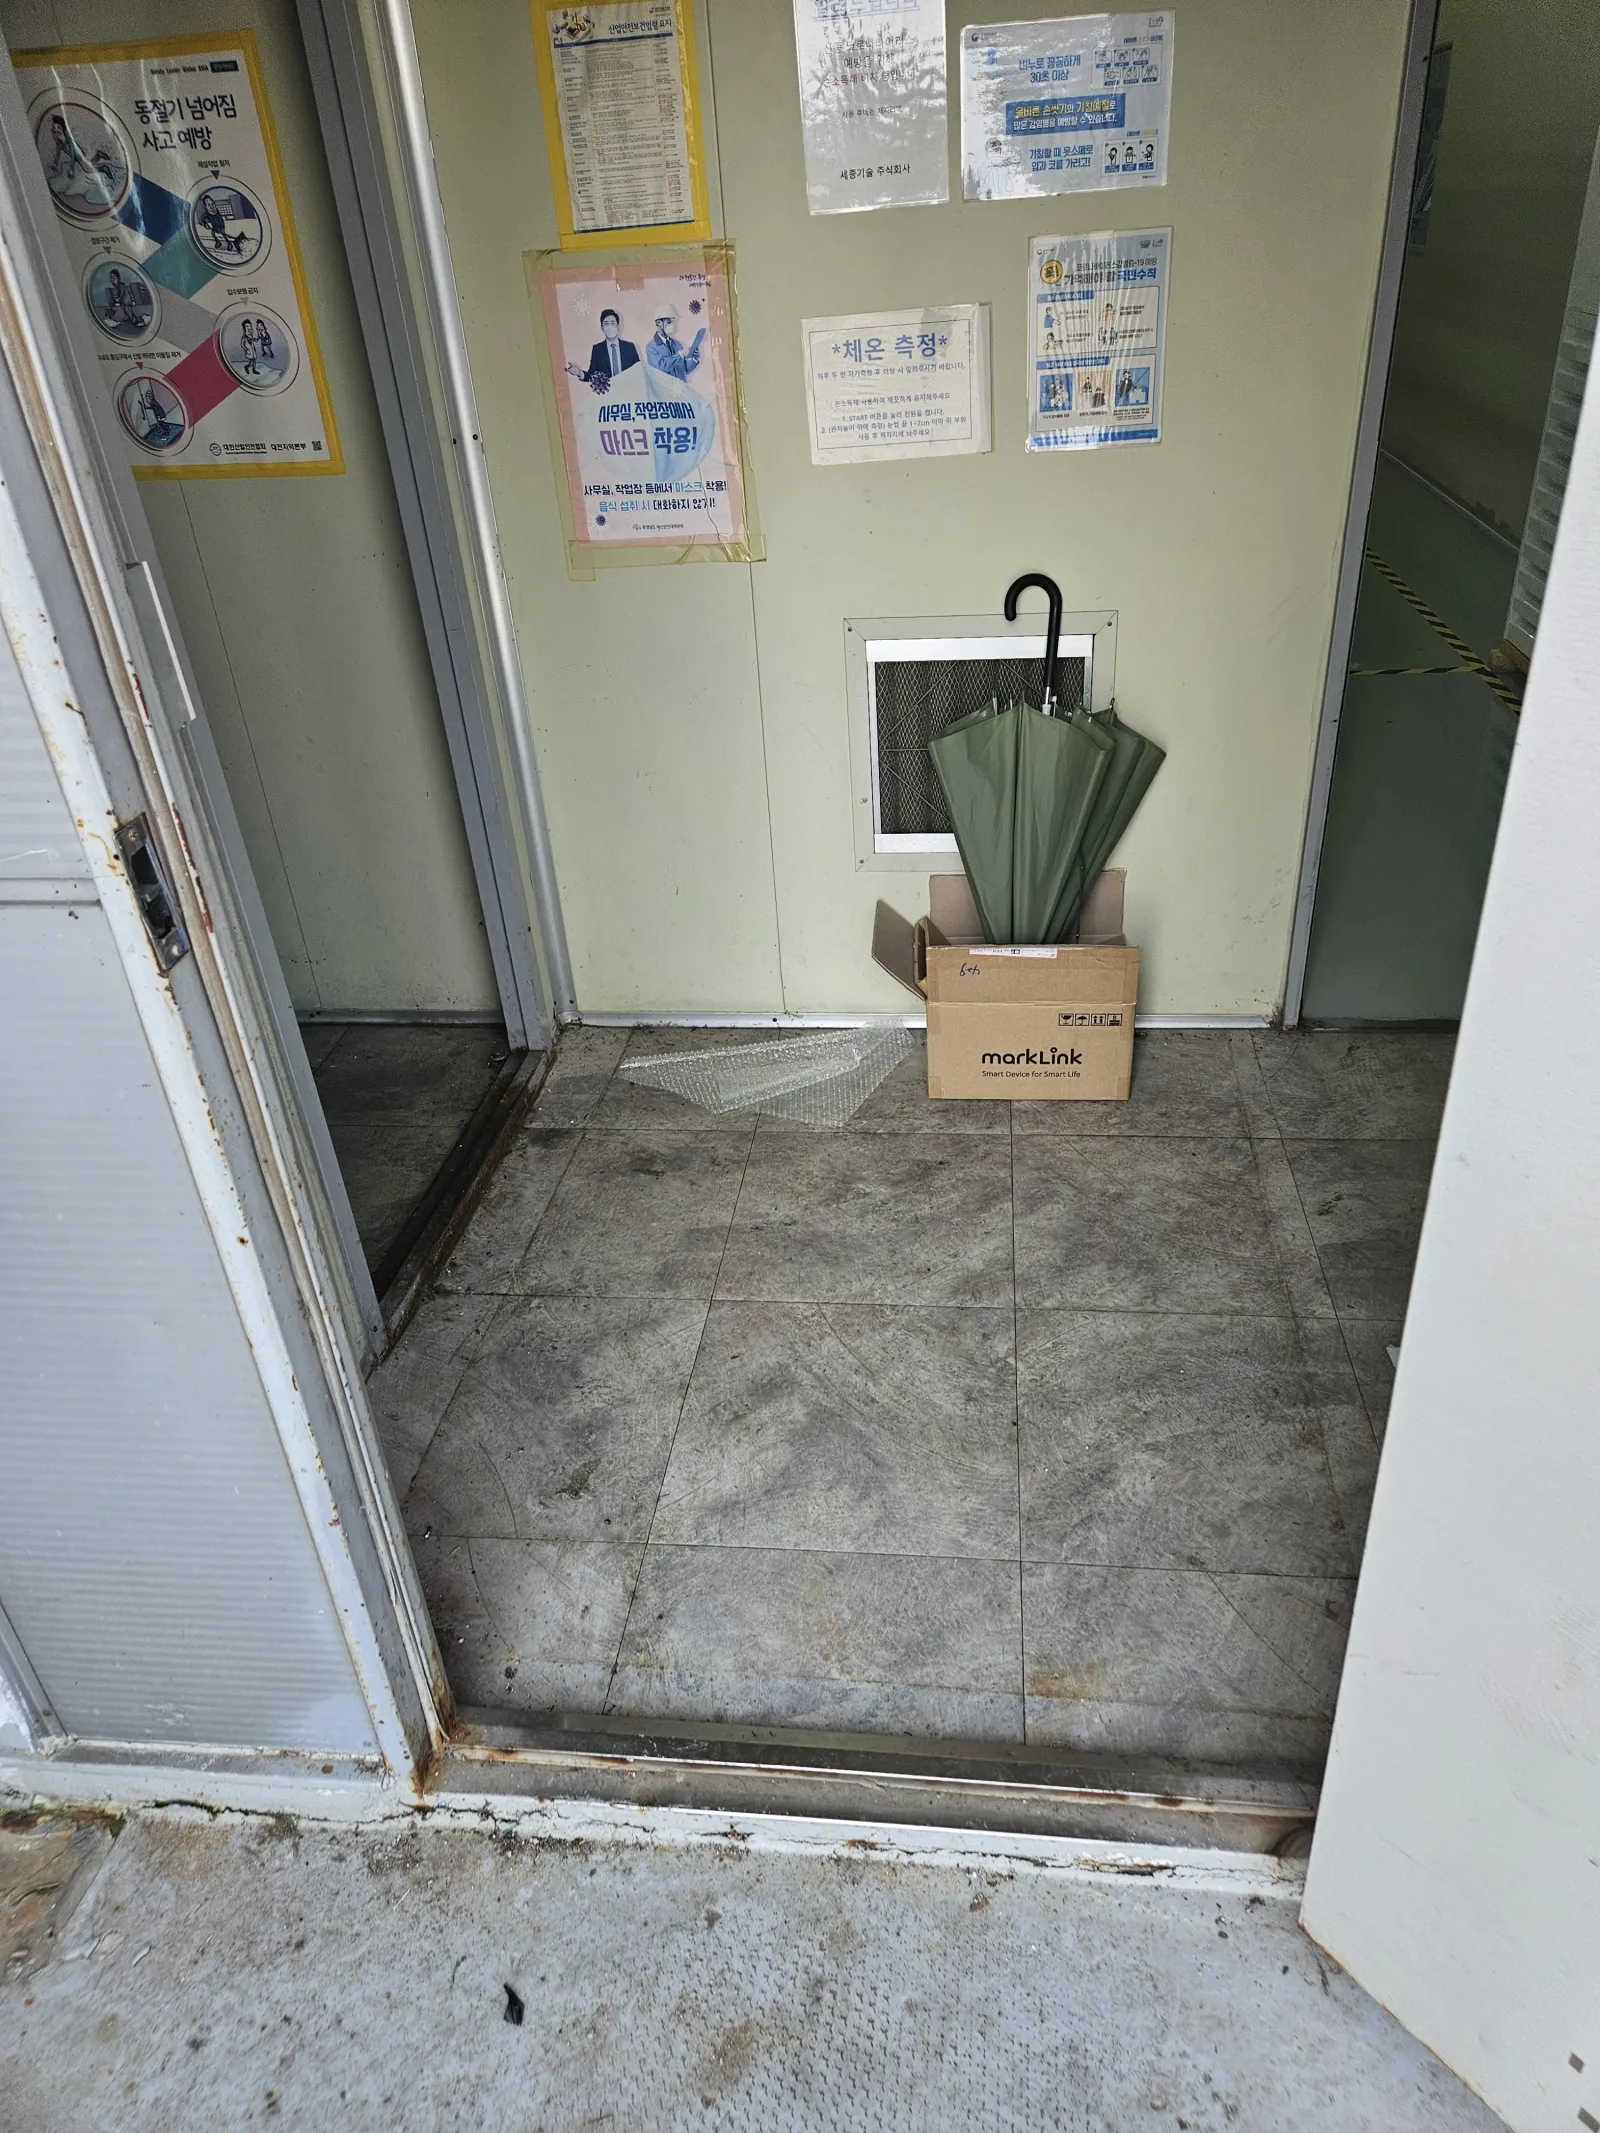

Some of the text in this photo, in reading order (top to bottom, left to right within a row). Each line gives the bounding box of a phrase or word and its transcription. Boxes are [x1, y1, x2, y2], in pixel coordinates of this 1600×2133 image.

[1019, 58, 1044, 70] 비누로
[1047, 54, 1080, 68] 꼼꼼하게
[1031, 69, 1069, 83] 30초 이상
[135, 94, 237, 125] 동절기 넘어짐
[1015, 100, 1116, 118] 올바른 손씻기와 기침예절로
[1013, 120, 1028, 130] 많은
[1057, 117, 1077, 127] 예방할
[1080, 115, 1086, 125] 수
[142, 126, 212, 152] 사고 예방
[1030, 148, 1051, 159] 기침할
[1054, 148, 1061, 157] 때
[841, 163, 910, 180] 세종기술 주식회사
[1031, 157, 1090, 172] 입과 코를 가리고!
[1118, 268, 1156, 281] 국민수칙
[906, 364, 937, 373] 알려주시기
[938, 362, 966, 370] 바랍니다.
[835, 399, 859, 408] 손소독제
[887, 395, 912, 404] 깨끗하게
[914, 392, 950, 402] 유지해주세요
[600, 427, 697, 455] 마스크 착용!
[584, 480, 728, 496] 사무실, 작업장 등에서 마스크 착용!
[599, 498, 715, 512] 음식 섭취 시 대화하지 않기!
[982, 1047, 1082, 1064] markLink
